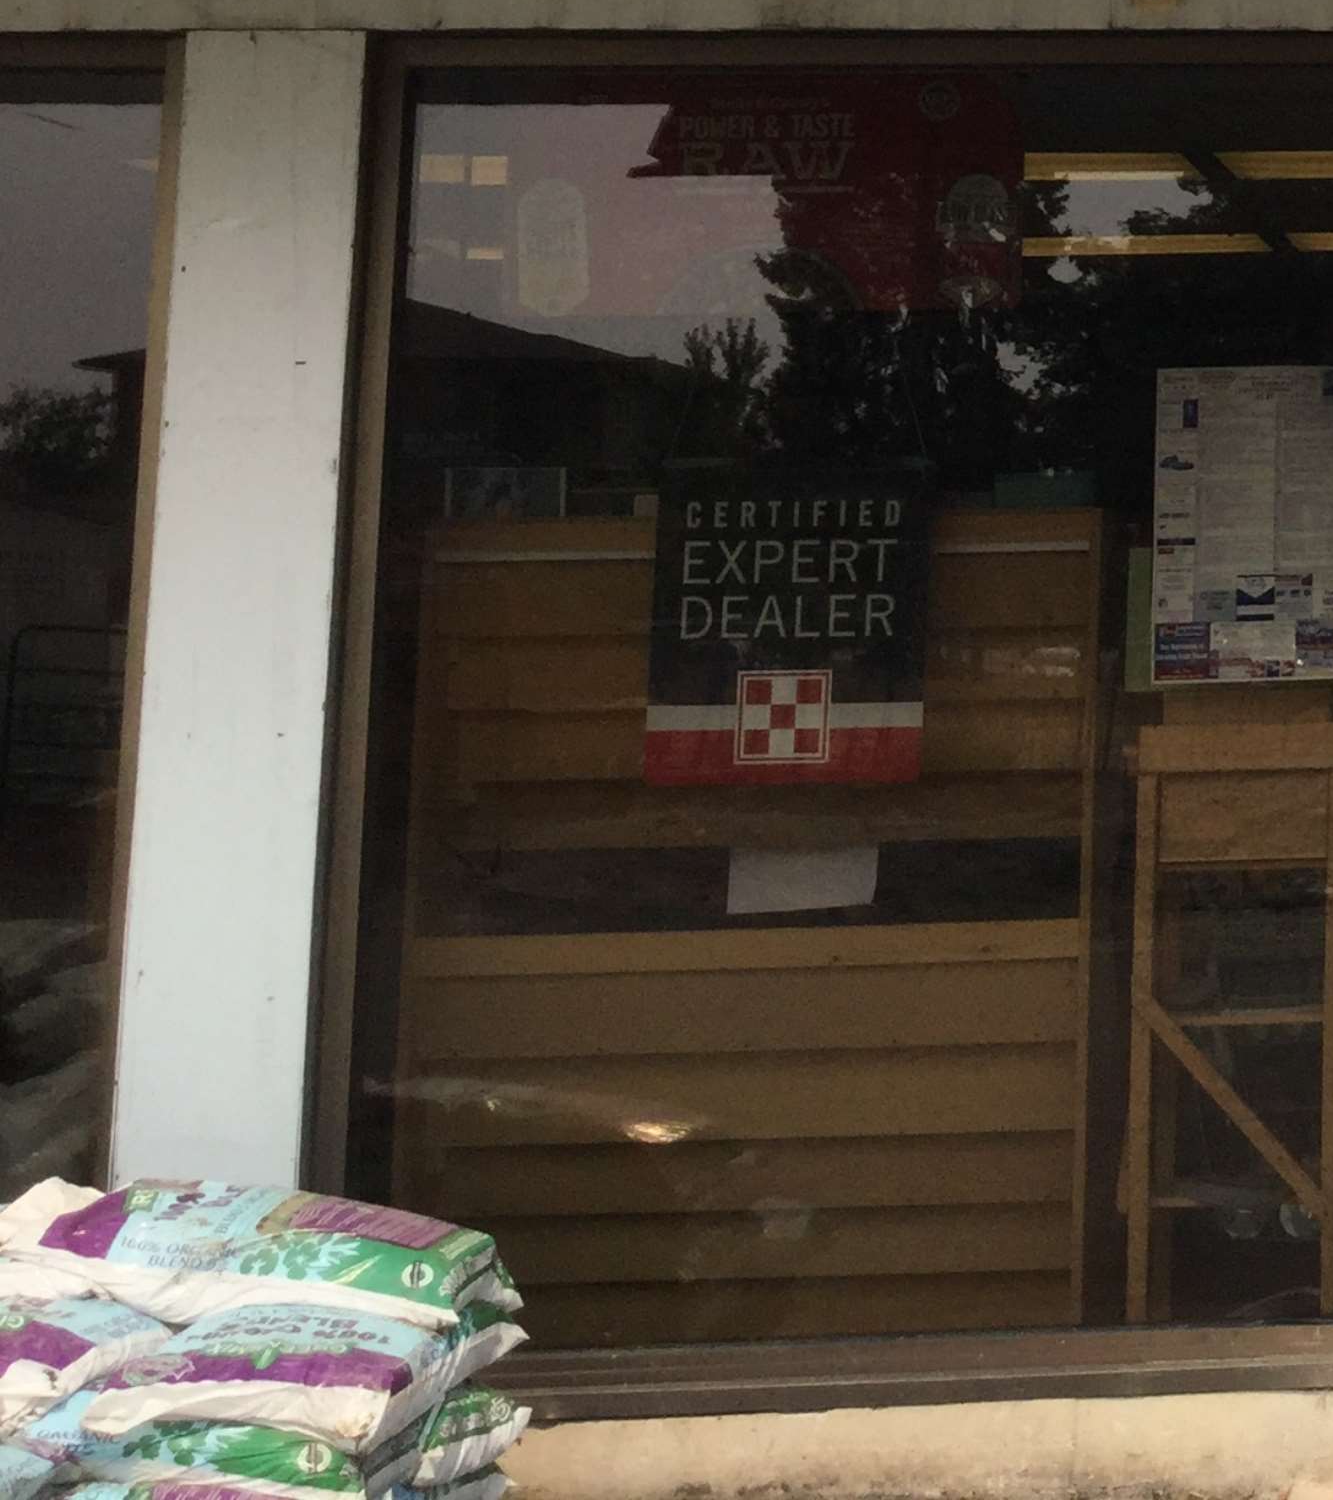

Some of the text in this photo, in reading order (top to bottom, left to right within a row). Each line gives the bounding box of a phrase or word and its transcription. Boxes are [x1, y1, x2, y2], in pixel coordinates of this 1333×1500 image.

[676, 113, 758, 140] POWER
[789, 112, 857, 139] TASTE
[680, 140, 855, 182] RAW
[685, 499, 902, 530] CERTIFIED
[682, 537, 900, 586] EXPERT
[679, 593, 897, 640] DEALER
